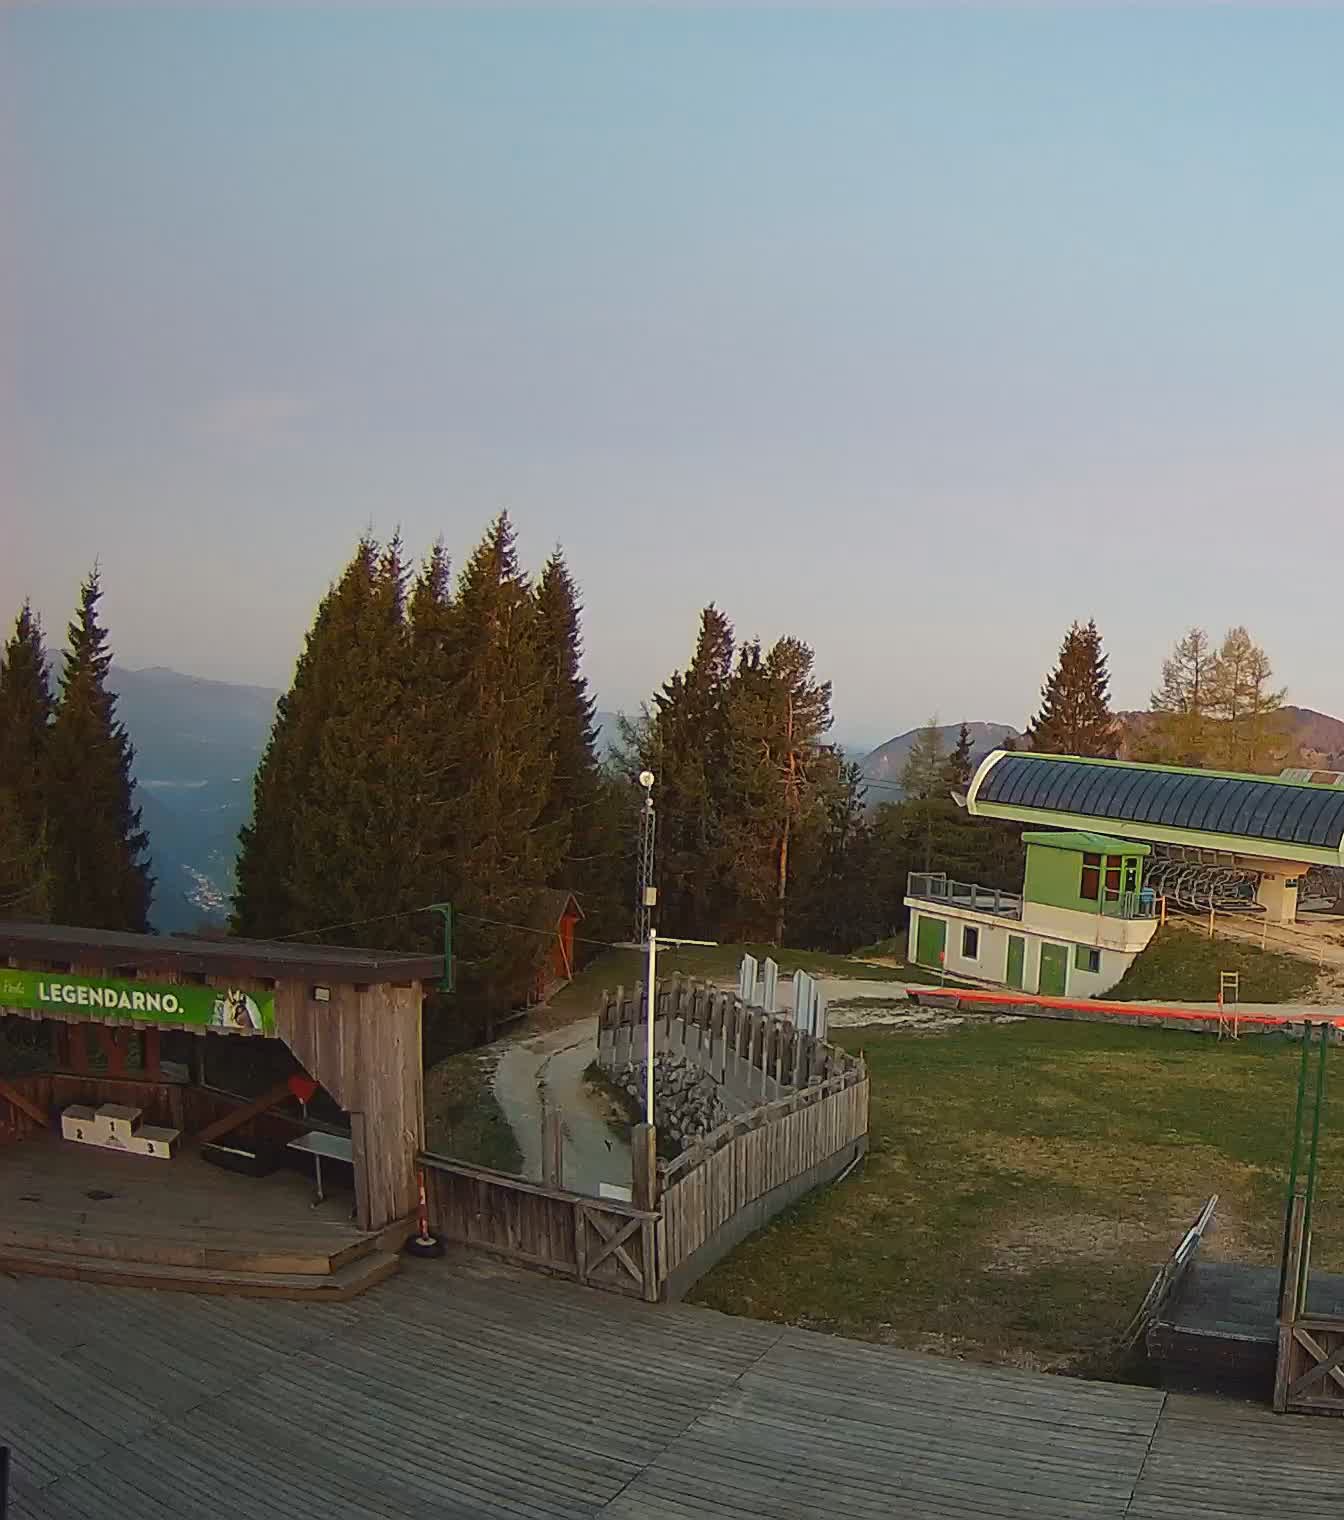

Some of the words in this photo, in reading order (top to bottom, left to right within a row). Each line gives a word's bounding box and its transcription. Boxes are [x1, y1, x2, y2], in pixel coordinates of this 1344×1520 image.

[38, 981, 185, 1014] LEGENDARNO.
[109, 1120, 116, 1132] 1
[76, 1128, 84, 1140] 2
[146, 1142, 155, 1154] 3
